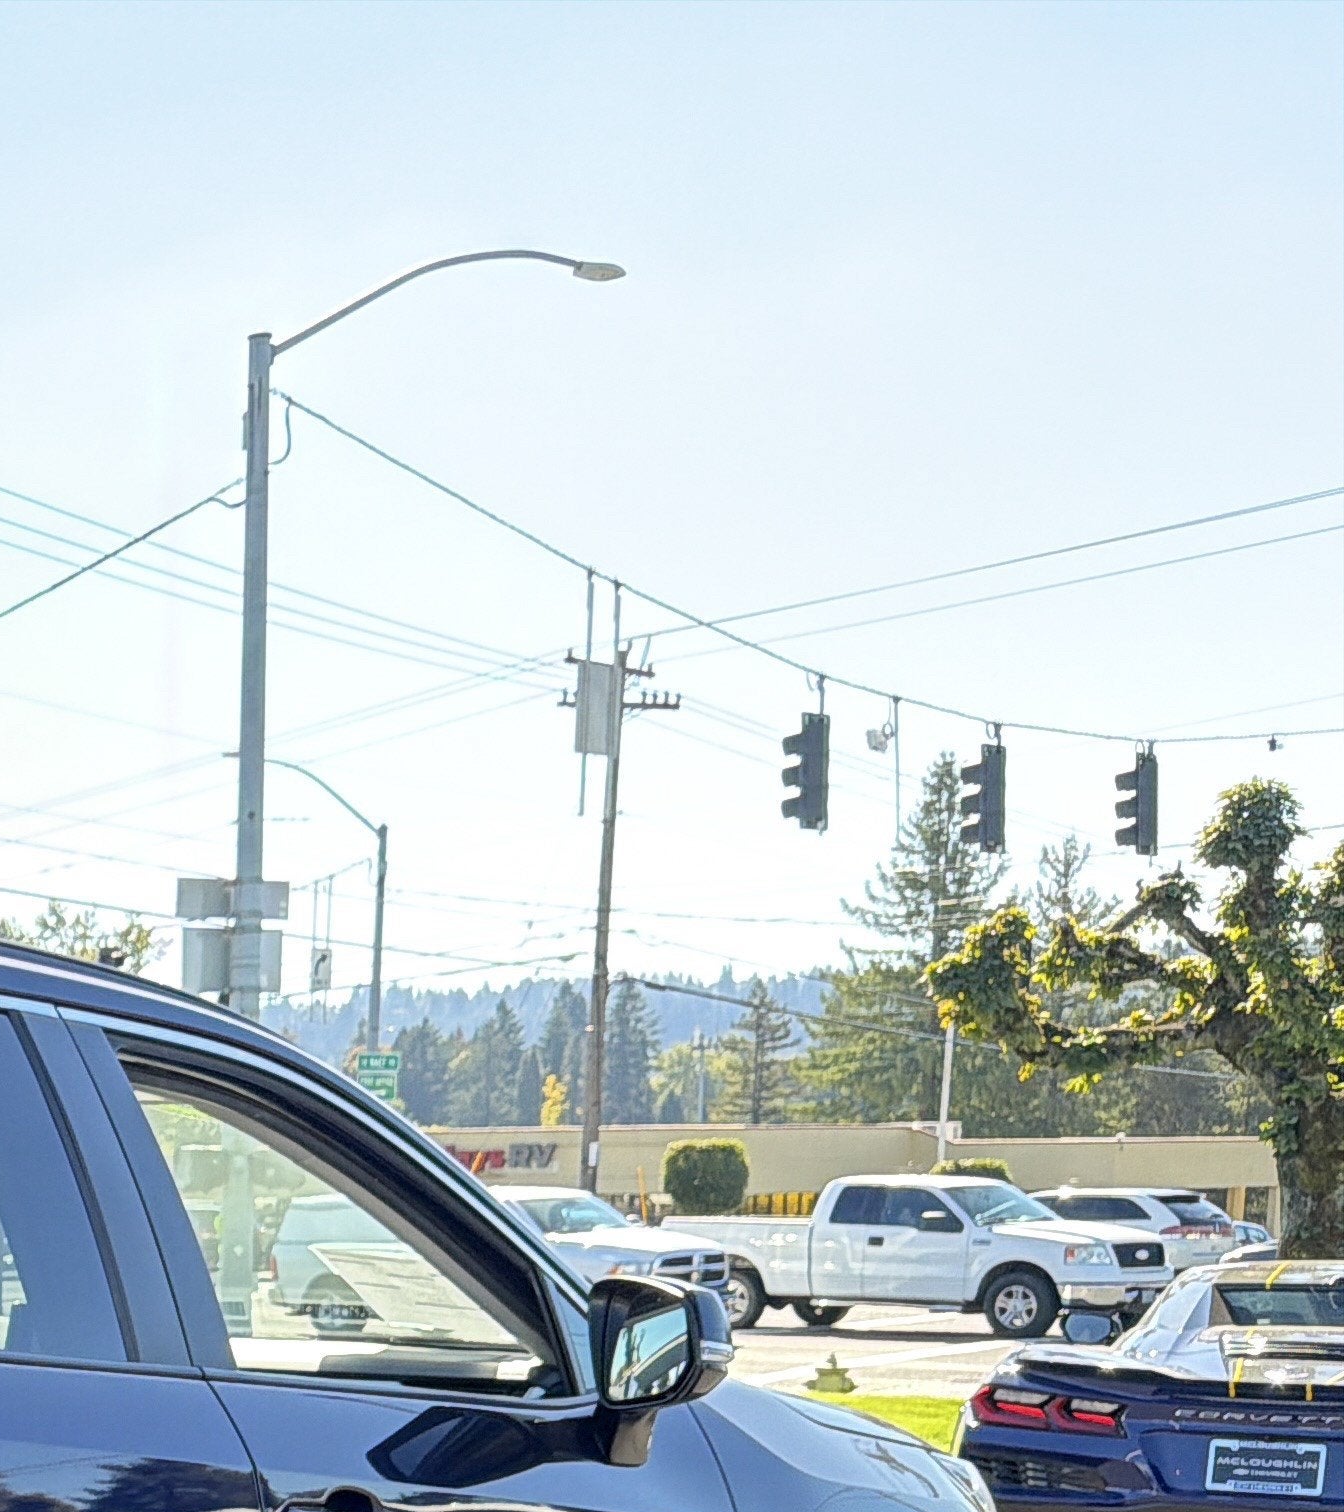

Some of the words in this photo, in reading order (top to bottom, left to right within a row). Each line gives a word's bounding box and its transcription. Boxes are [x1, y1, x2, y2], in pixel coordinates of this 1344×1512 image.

[509, 1143, 557, 1168] RV
[1174, 1409, 1344, 1423] CORVETT
[1216, 1456, 1318, 1470] MCLOUGHLIN
